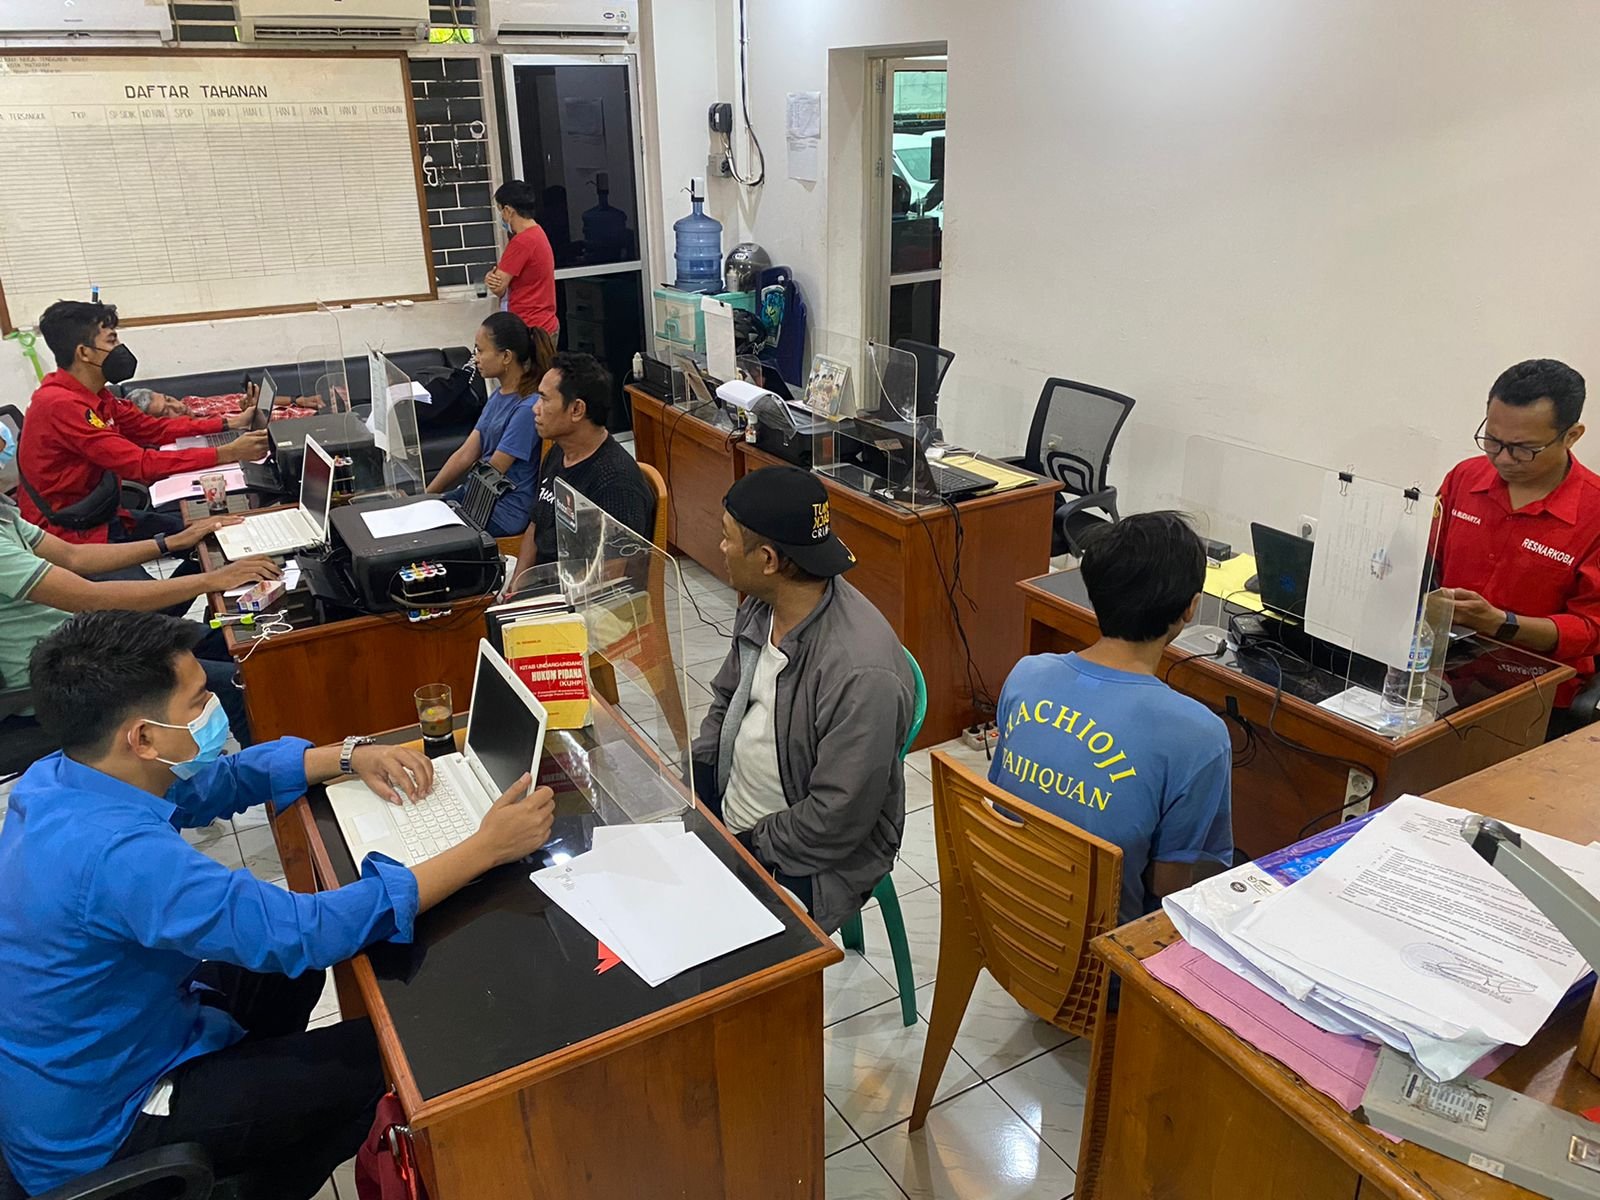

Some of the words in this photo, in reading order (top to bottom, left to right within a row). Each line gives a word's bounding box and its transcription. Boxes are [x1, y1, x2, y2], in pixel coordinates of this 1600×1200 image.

[124, 85, 190, 99] DAFTAR
[200, 85, 268, 98] TAHANAN
[1521, 537, 1575, 566] RESNARKOBA
[519, 663, 536, 671] KITAB
[531, 670, 557, 682] HUKUM
[558, 668, 583, 680] PIDANA
